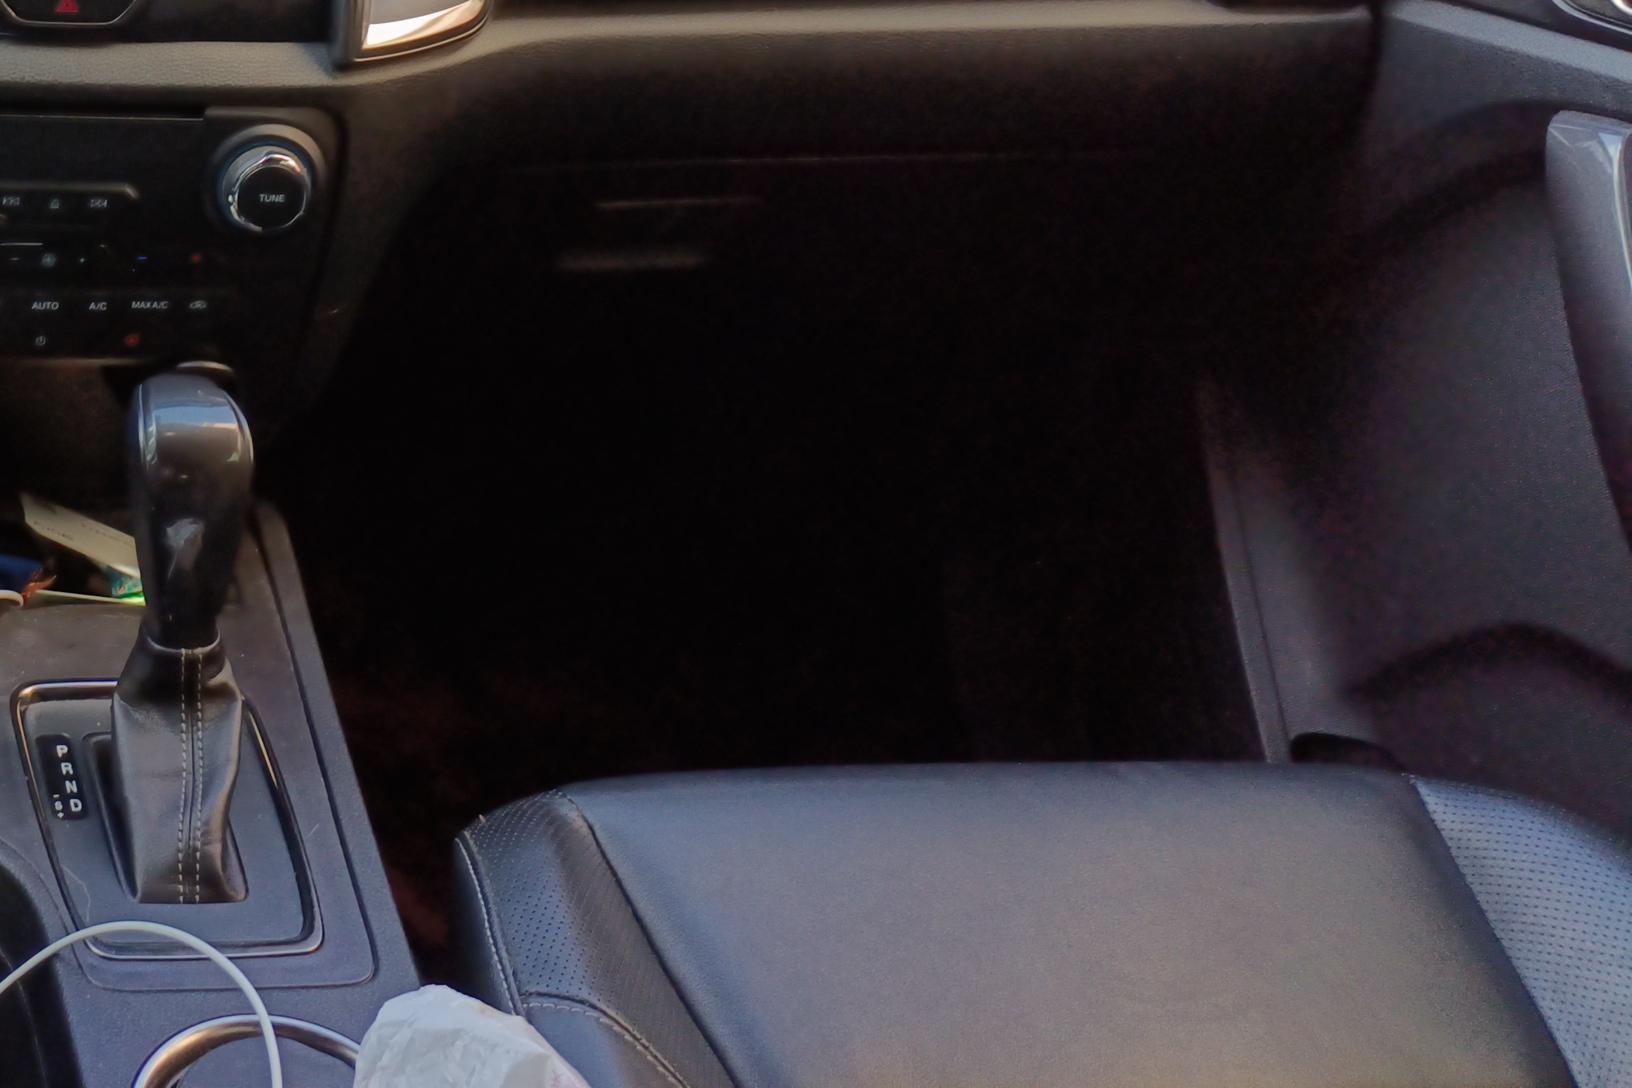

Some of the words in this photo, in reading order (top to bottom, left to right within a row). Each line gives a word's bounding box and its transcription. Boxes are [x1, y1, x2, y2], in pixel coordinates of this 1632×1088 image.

[259, 193, 286, 203] TUNE
[31, 301, 60, 311] AUTO
[89, 302, 109, 311] A/C
[56, 744, 68, 758] P
[60, 762, 74, 775] R
[65, 780, 78, 794] N
[69, 798, 82, 812] D
